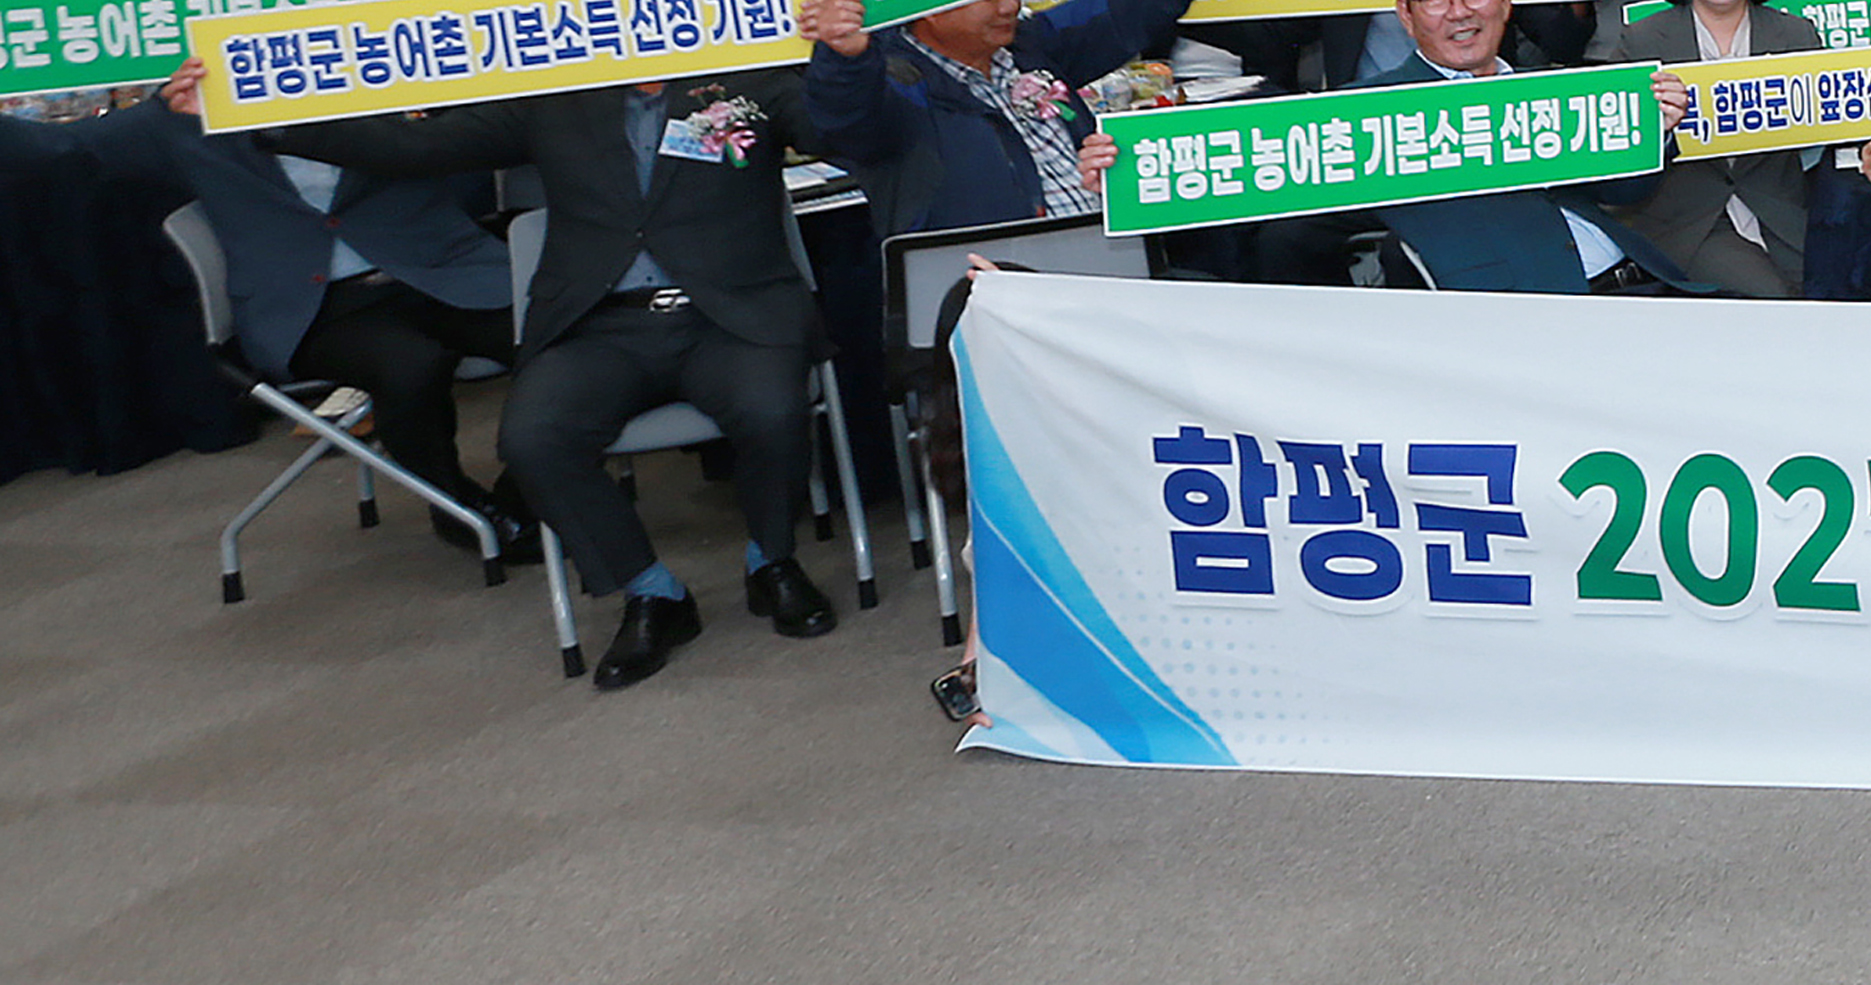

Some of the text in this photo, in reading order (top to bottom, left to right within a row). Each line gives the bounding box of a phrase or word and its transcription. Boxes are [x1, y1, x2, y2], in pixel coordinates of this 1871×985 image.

[226, 28, 347, 101] 함평군
[353, 13, 470, 86] 농어촌
[1713, 75, 1813, 134] 함평군이
[1133, 89, 1641, 204] 함평군 농어촌 기본소득 선정 기원!
[1153, 426, 1532, 607] 함평군
